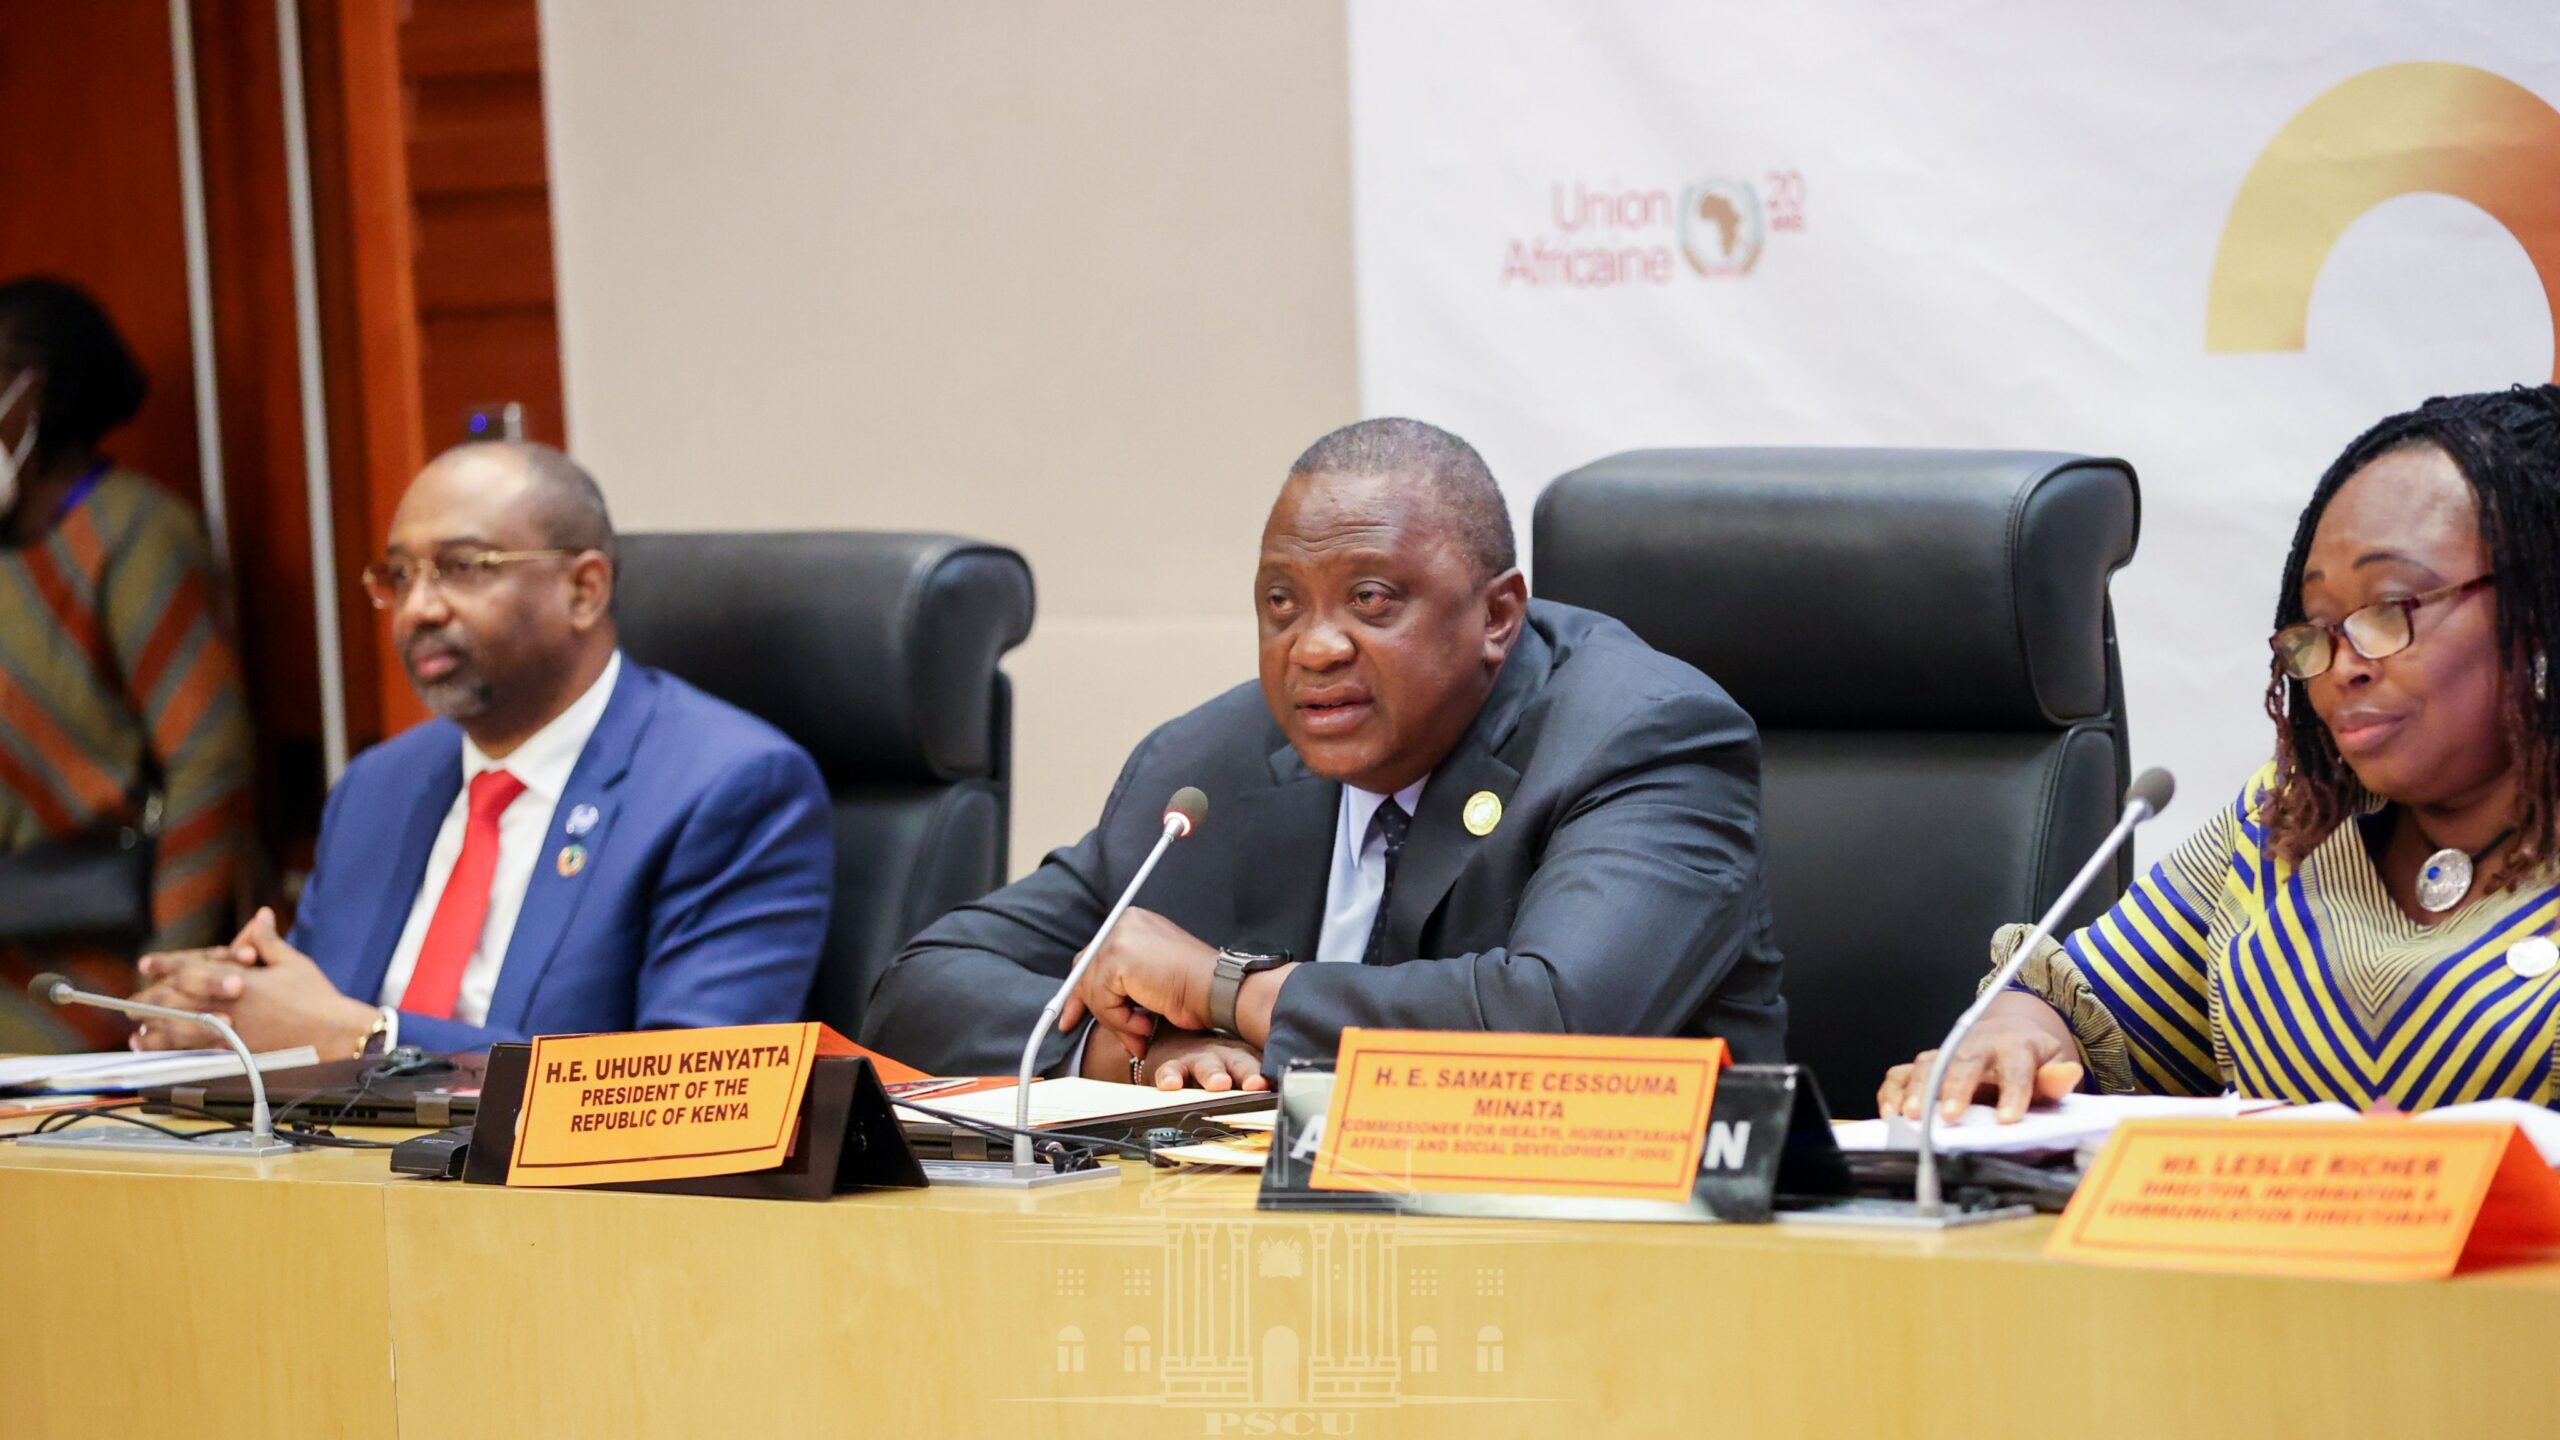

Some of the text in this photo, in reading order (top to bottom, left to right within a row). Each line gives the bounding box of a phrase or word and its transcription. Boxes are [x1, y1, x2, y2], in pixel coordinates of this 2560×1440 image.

[1551, 177, 1672, 232] Union
[1500, 237, 1674, 287] Africaine
[546, 1045, 790, 1083] H.E. UHURU KENYATTA
[581, 1078, 749, 1107] PRESIDENT OF THE
[1375, 1067, 1678, 1095] H. E. SAMATE CESSOUMA
[571, 1102, 749, 1132] REPUBLIC OF KENYA
[1473, 1098, 1564, 1118] MINATA
[1342, 1119, 1692, 1143] COMMISSIONER FOR HEALTH, HUMANITARIAN
[1351, 1136, 1409, 1150] AFFAIRS
[1416, 1138, 1448, 1152] AND
[1454, 1140, 1506, 1154] SOCIAL
[1512, 1142, 1625, 1158] DEVELOPMENT
[2213, 1154, 2316, 1177] LESLIE
[2328, 1155, 2442, 1177] RICHER
[2264, 1184, 2415, 1201] INFORMATION
[2107, 1203, 2453, 1226] COMMUNICATION DIRECTORATE
